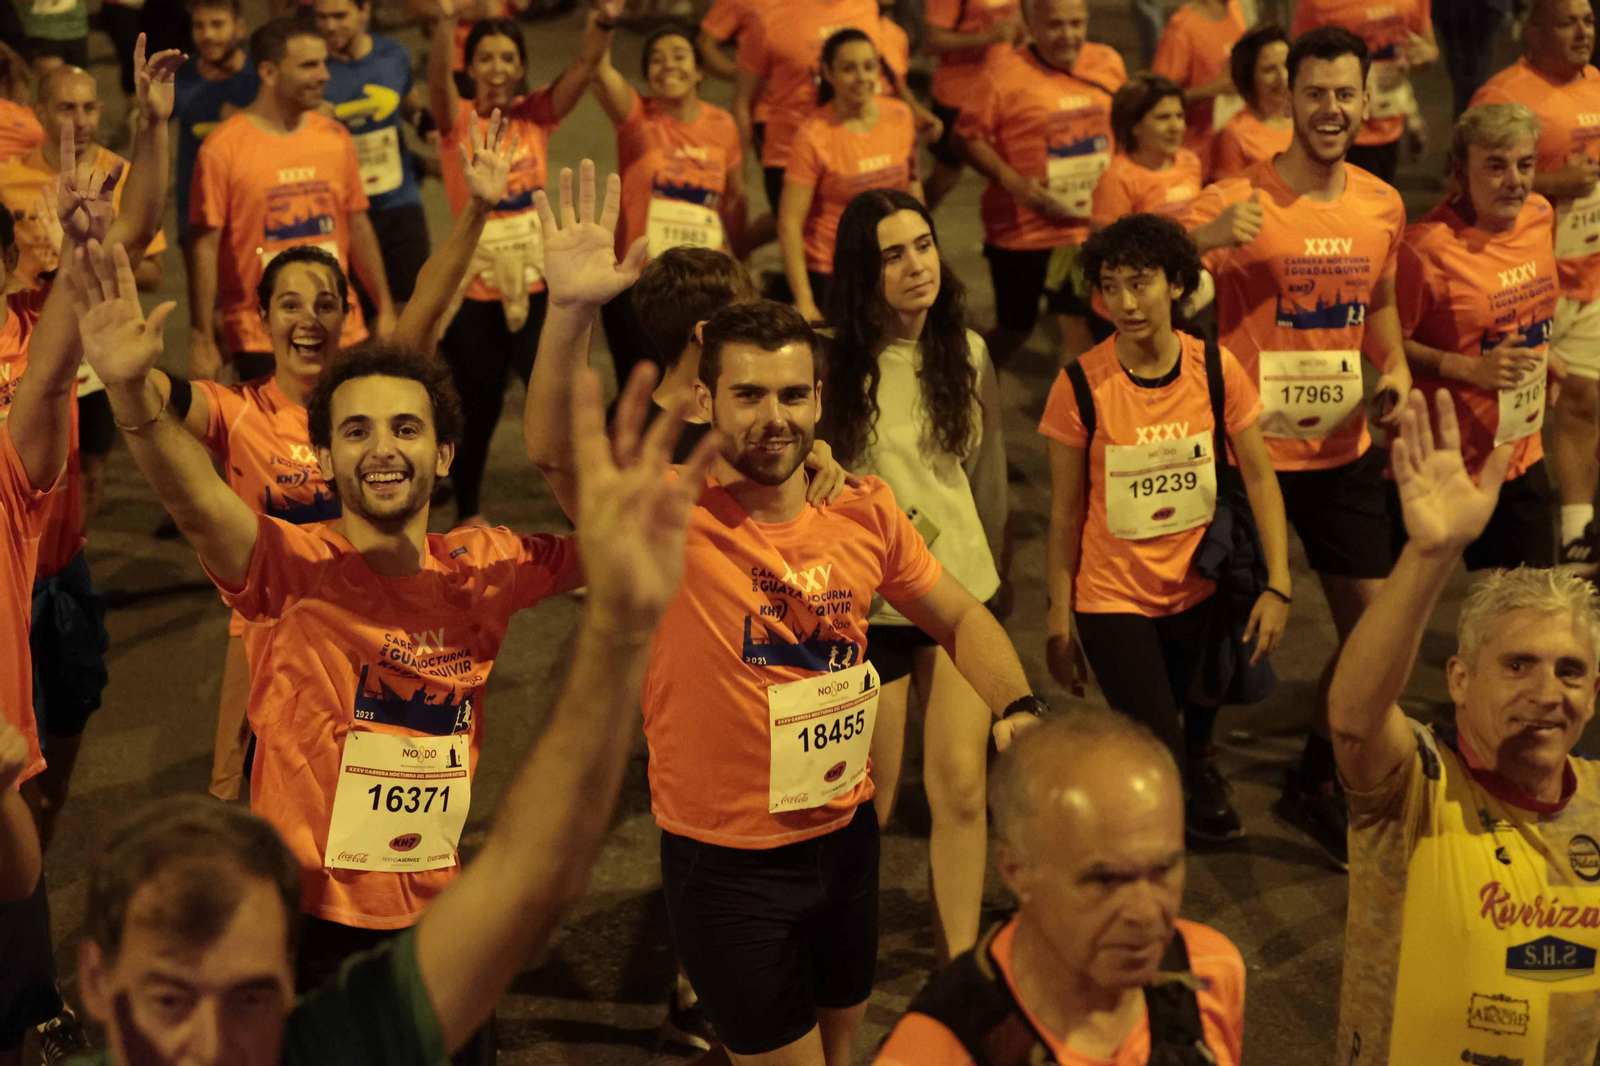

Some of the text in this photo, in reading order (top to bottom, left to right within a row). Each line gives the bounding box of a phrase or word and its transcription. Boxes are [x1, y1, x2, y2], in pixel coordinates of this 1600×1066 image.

[1305, 238, 1352, 255] XXXV
[1291, 265, 1370, 275] GUADALQUIVIR
[1498, 261, 1536, 288] XXXV
[1281, 385, 1344, 404] 17963
[1135, 421, 1189, 445] XXXV
[277, 473, 302, 484] KH7
[1130, 471, 1197, 498] 19239
[798, 709, 865, 752] 18455
[365, 768, 389, 776] CARRERA
[368, 783, 449, 813] 16371
